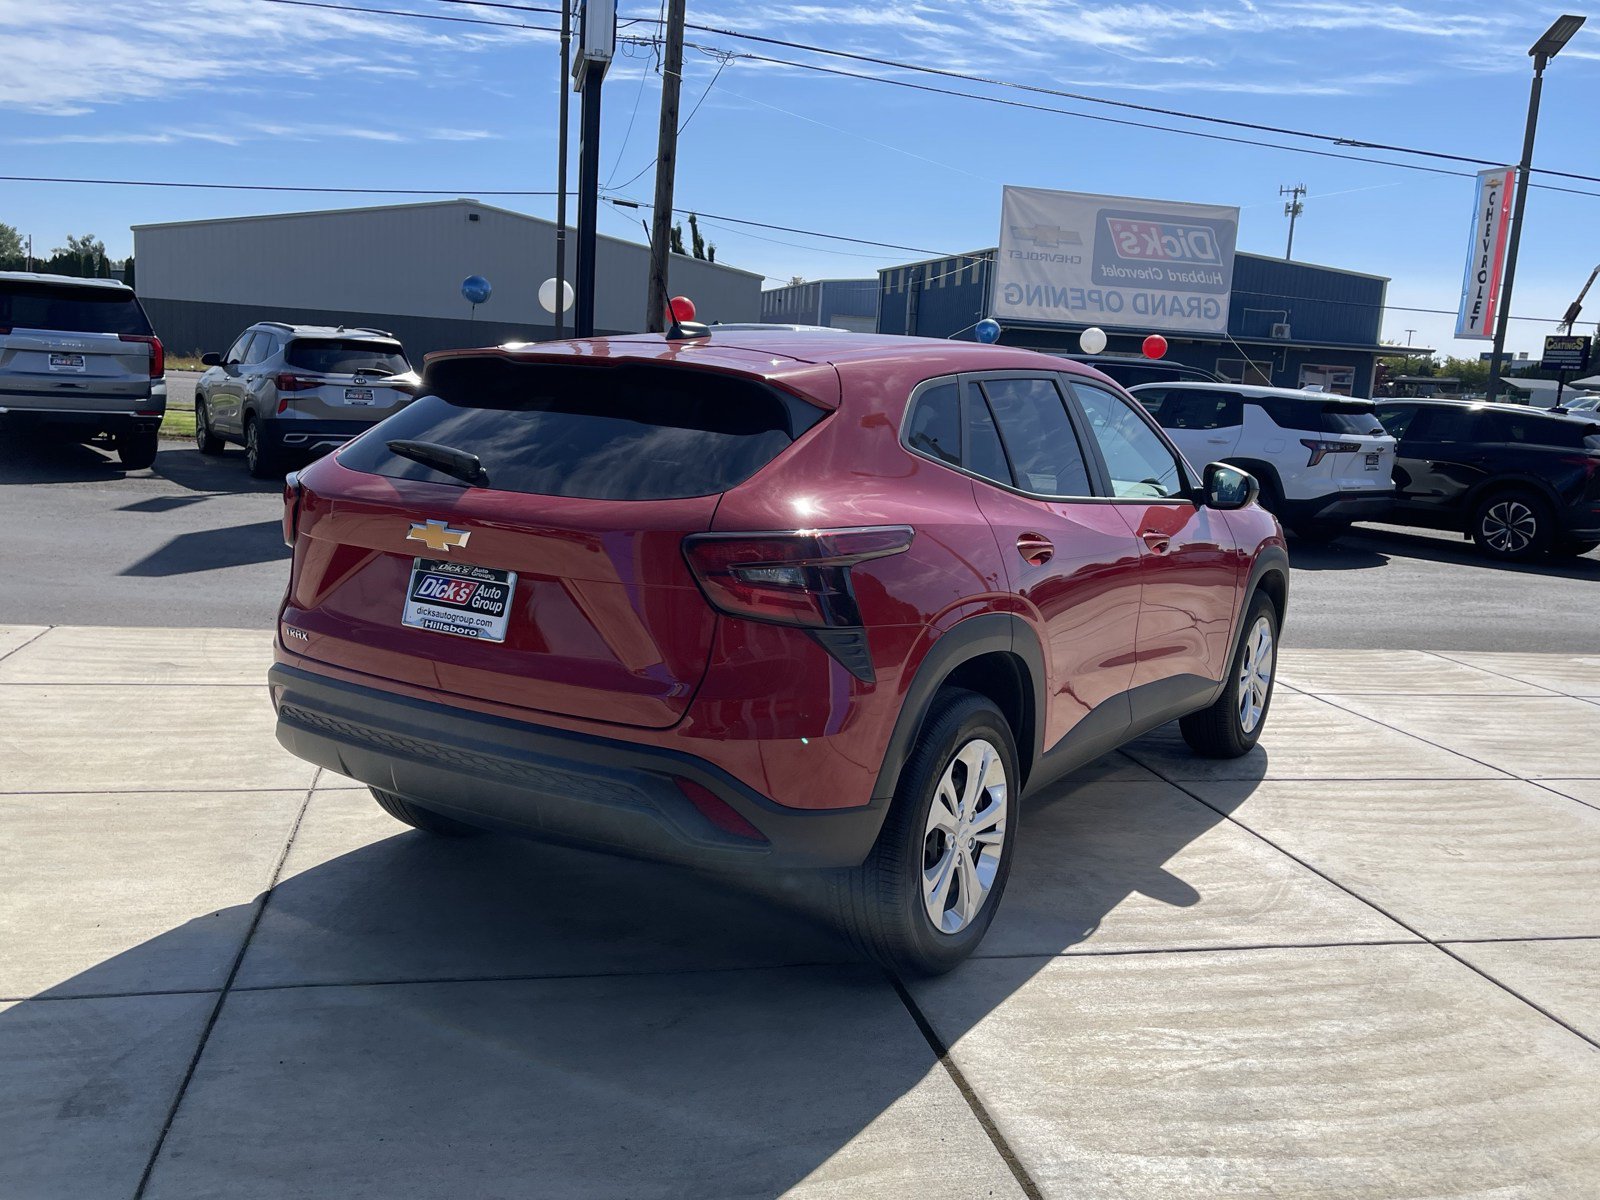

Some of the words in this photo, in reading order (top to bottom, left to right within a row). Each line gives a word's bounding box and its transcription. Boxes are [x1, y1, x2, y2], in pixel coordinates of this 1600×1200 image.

[1469, 191, 1496, 329] CHEVROLET
[438, 563, 470, 574] Dick's
[471, 571, 492, 579] Group
[419, 578, 470, 602] Dick's
[475, 584, 502, 599] Auto
[471, 595, 503, 614] Group
[416, 606, 493, 628] dicksautogroup.com
[424, 619, 477, 636] Hillsboro
